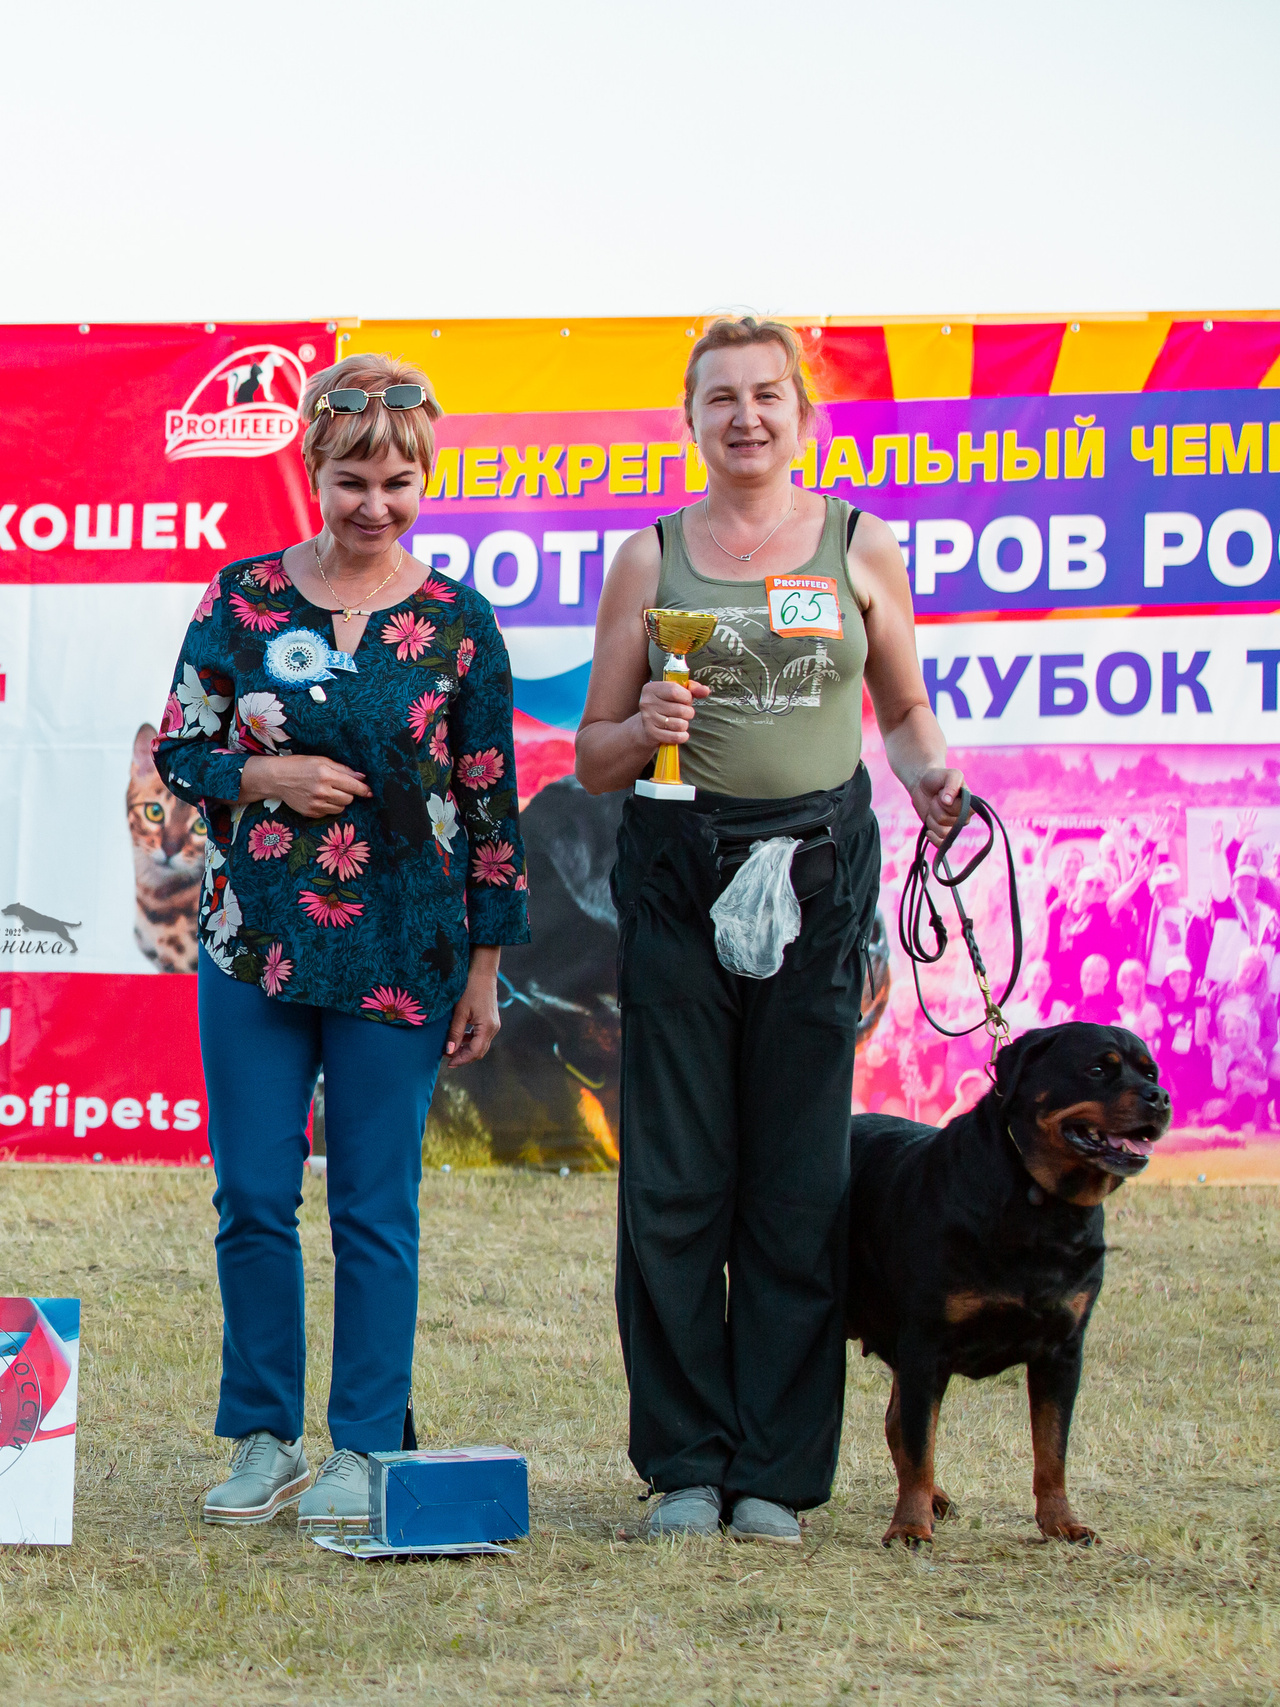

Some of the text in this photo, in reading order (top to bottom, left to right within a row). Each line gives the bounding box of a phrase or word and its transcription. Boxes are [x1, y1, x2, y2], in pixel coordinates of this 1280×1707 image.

[168, 412, 296, 437] PROFIFEED
[1143, 508, 1280, 588] РО
[773, 578, 829, 589] PROFIFEED
[781, 592, 833, 625] 65
[923, 651, 1212, 719] КУБОК
[1, 1345, 38, 1451] РОССИИ
